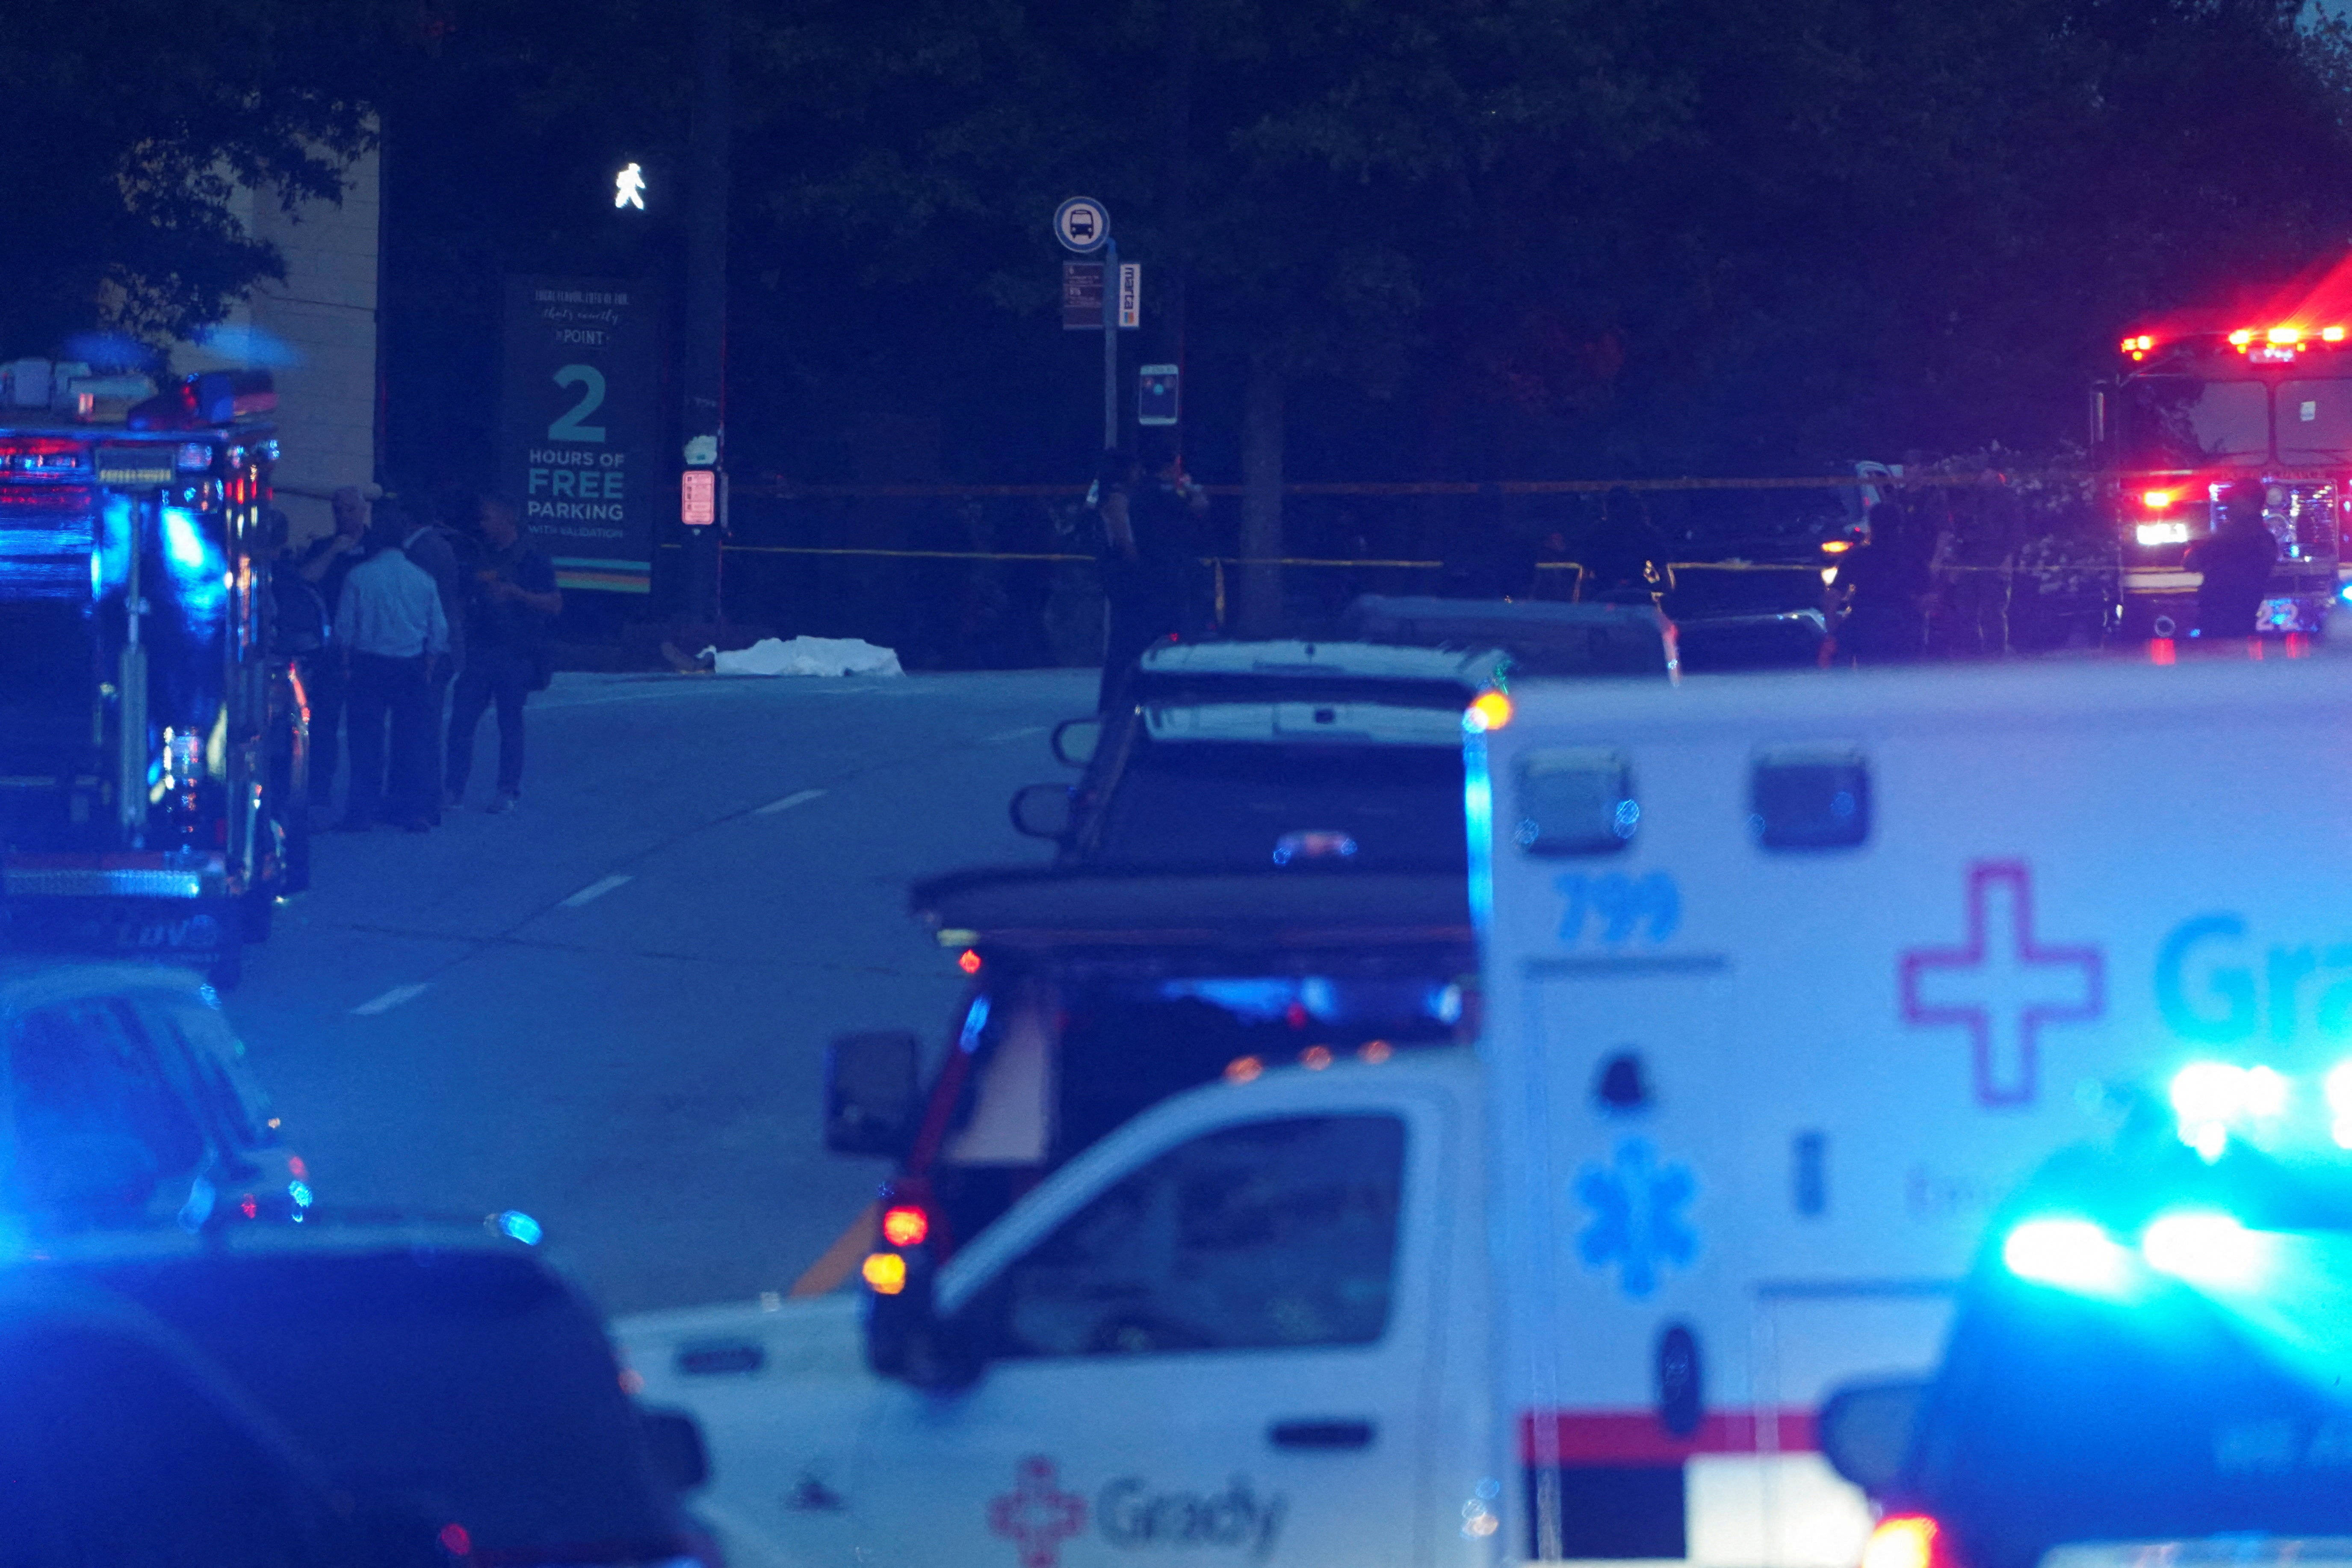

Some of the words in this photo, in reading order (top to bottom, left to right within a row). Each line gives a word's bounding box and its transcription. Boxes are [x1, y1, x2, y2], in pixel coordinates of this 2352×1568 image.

[1124, 267, 1134, 310] marta
[564, 328, 605, 345] POINT
[548, 363, 606, 443] 2
[529, 449, 594, 466] HOURS
[599, 453, 624, 467] OF
[529, 468, 625, 499] FREE
[528, 501, 623, 521] PARKING
[528, 525, 558, 534] WITH
[560, 526, 623, 538] VALIDATION
[1555, 873, 1680, 942] 799
[1097, 1474, 1289, 1562] Grady
